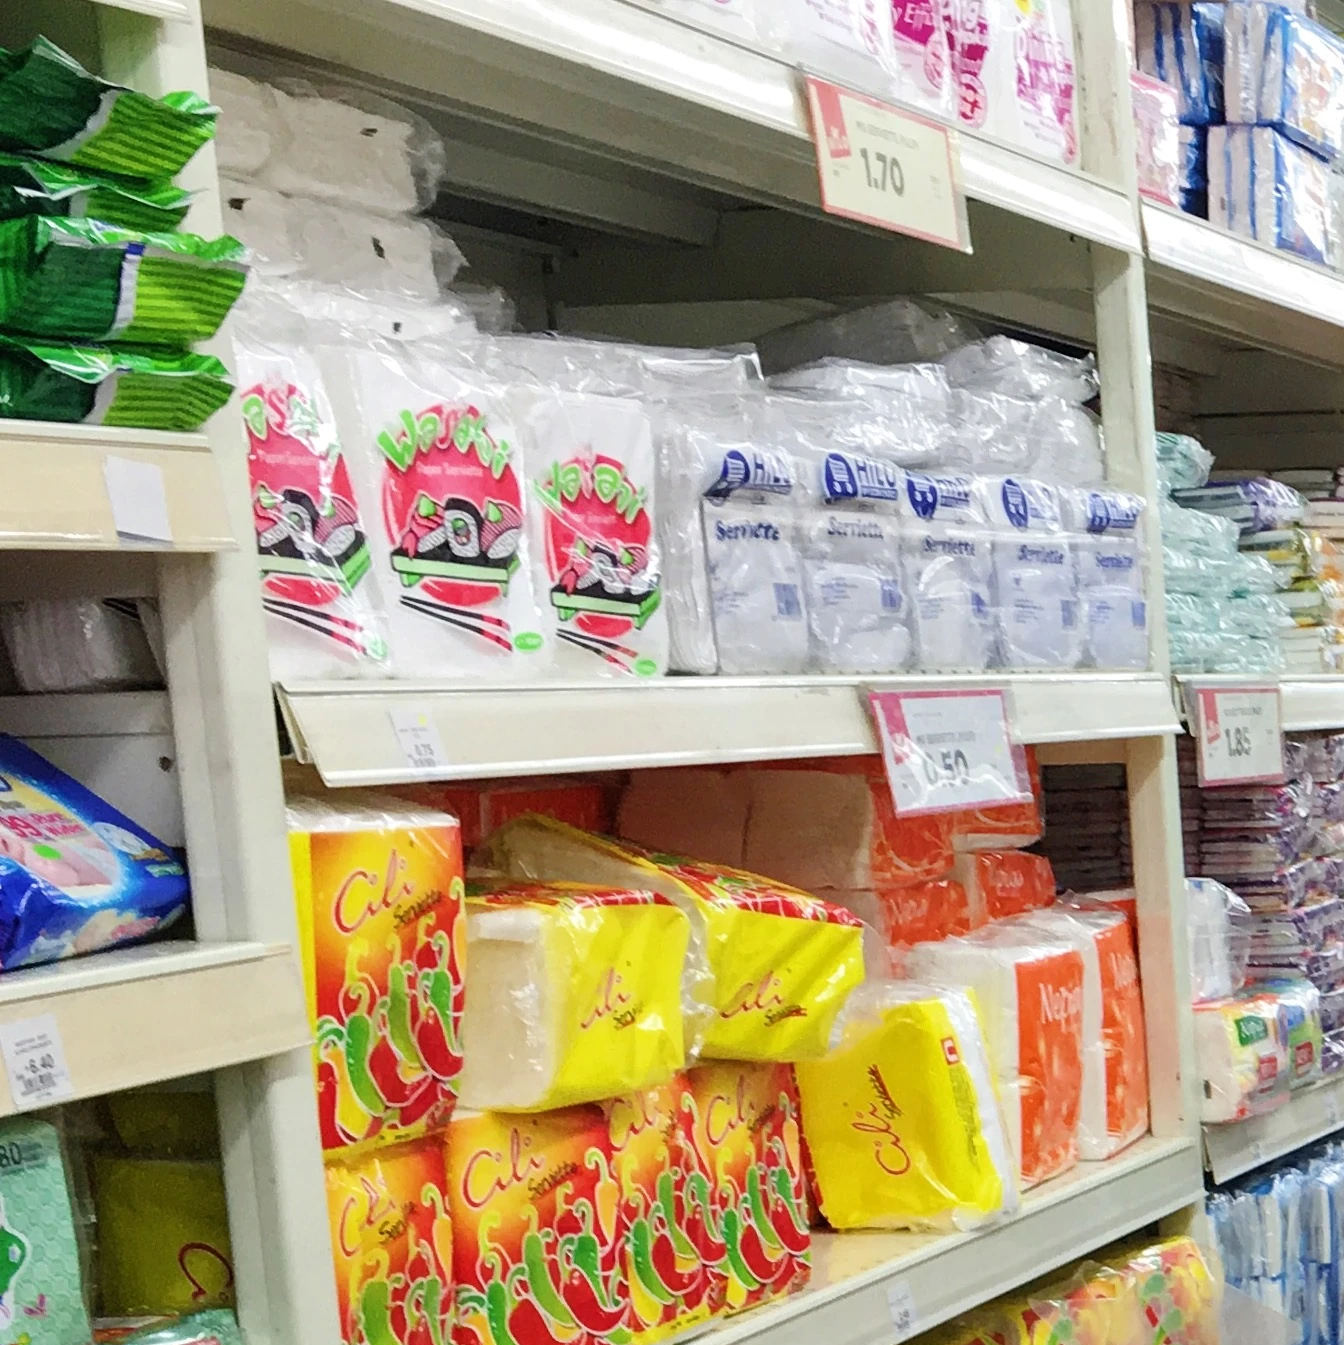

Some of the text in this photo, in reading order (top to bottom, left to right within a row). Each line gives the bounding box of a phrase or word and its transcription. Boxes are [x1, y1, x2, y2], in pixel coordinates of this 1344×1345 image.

[859, 147, 905, 197] 1.70
[376, 408, 511, 480] Wasabi
[714, 518, 781, 542] Serviette
